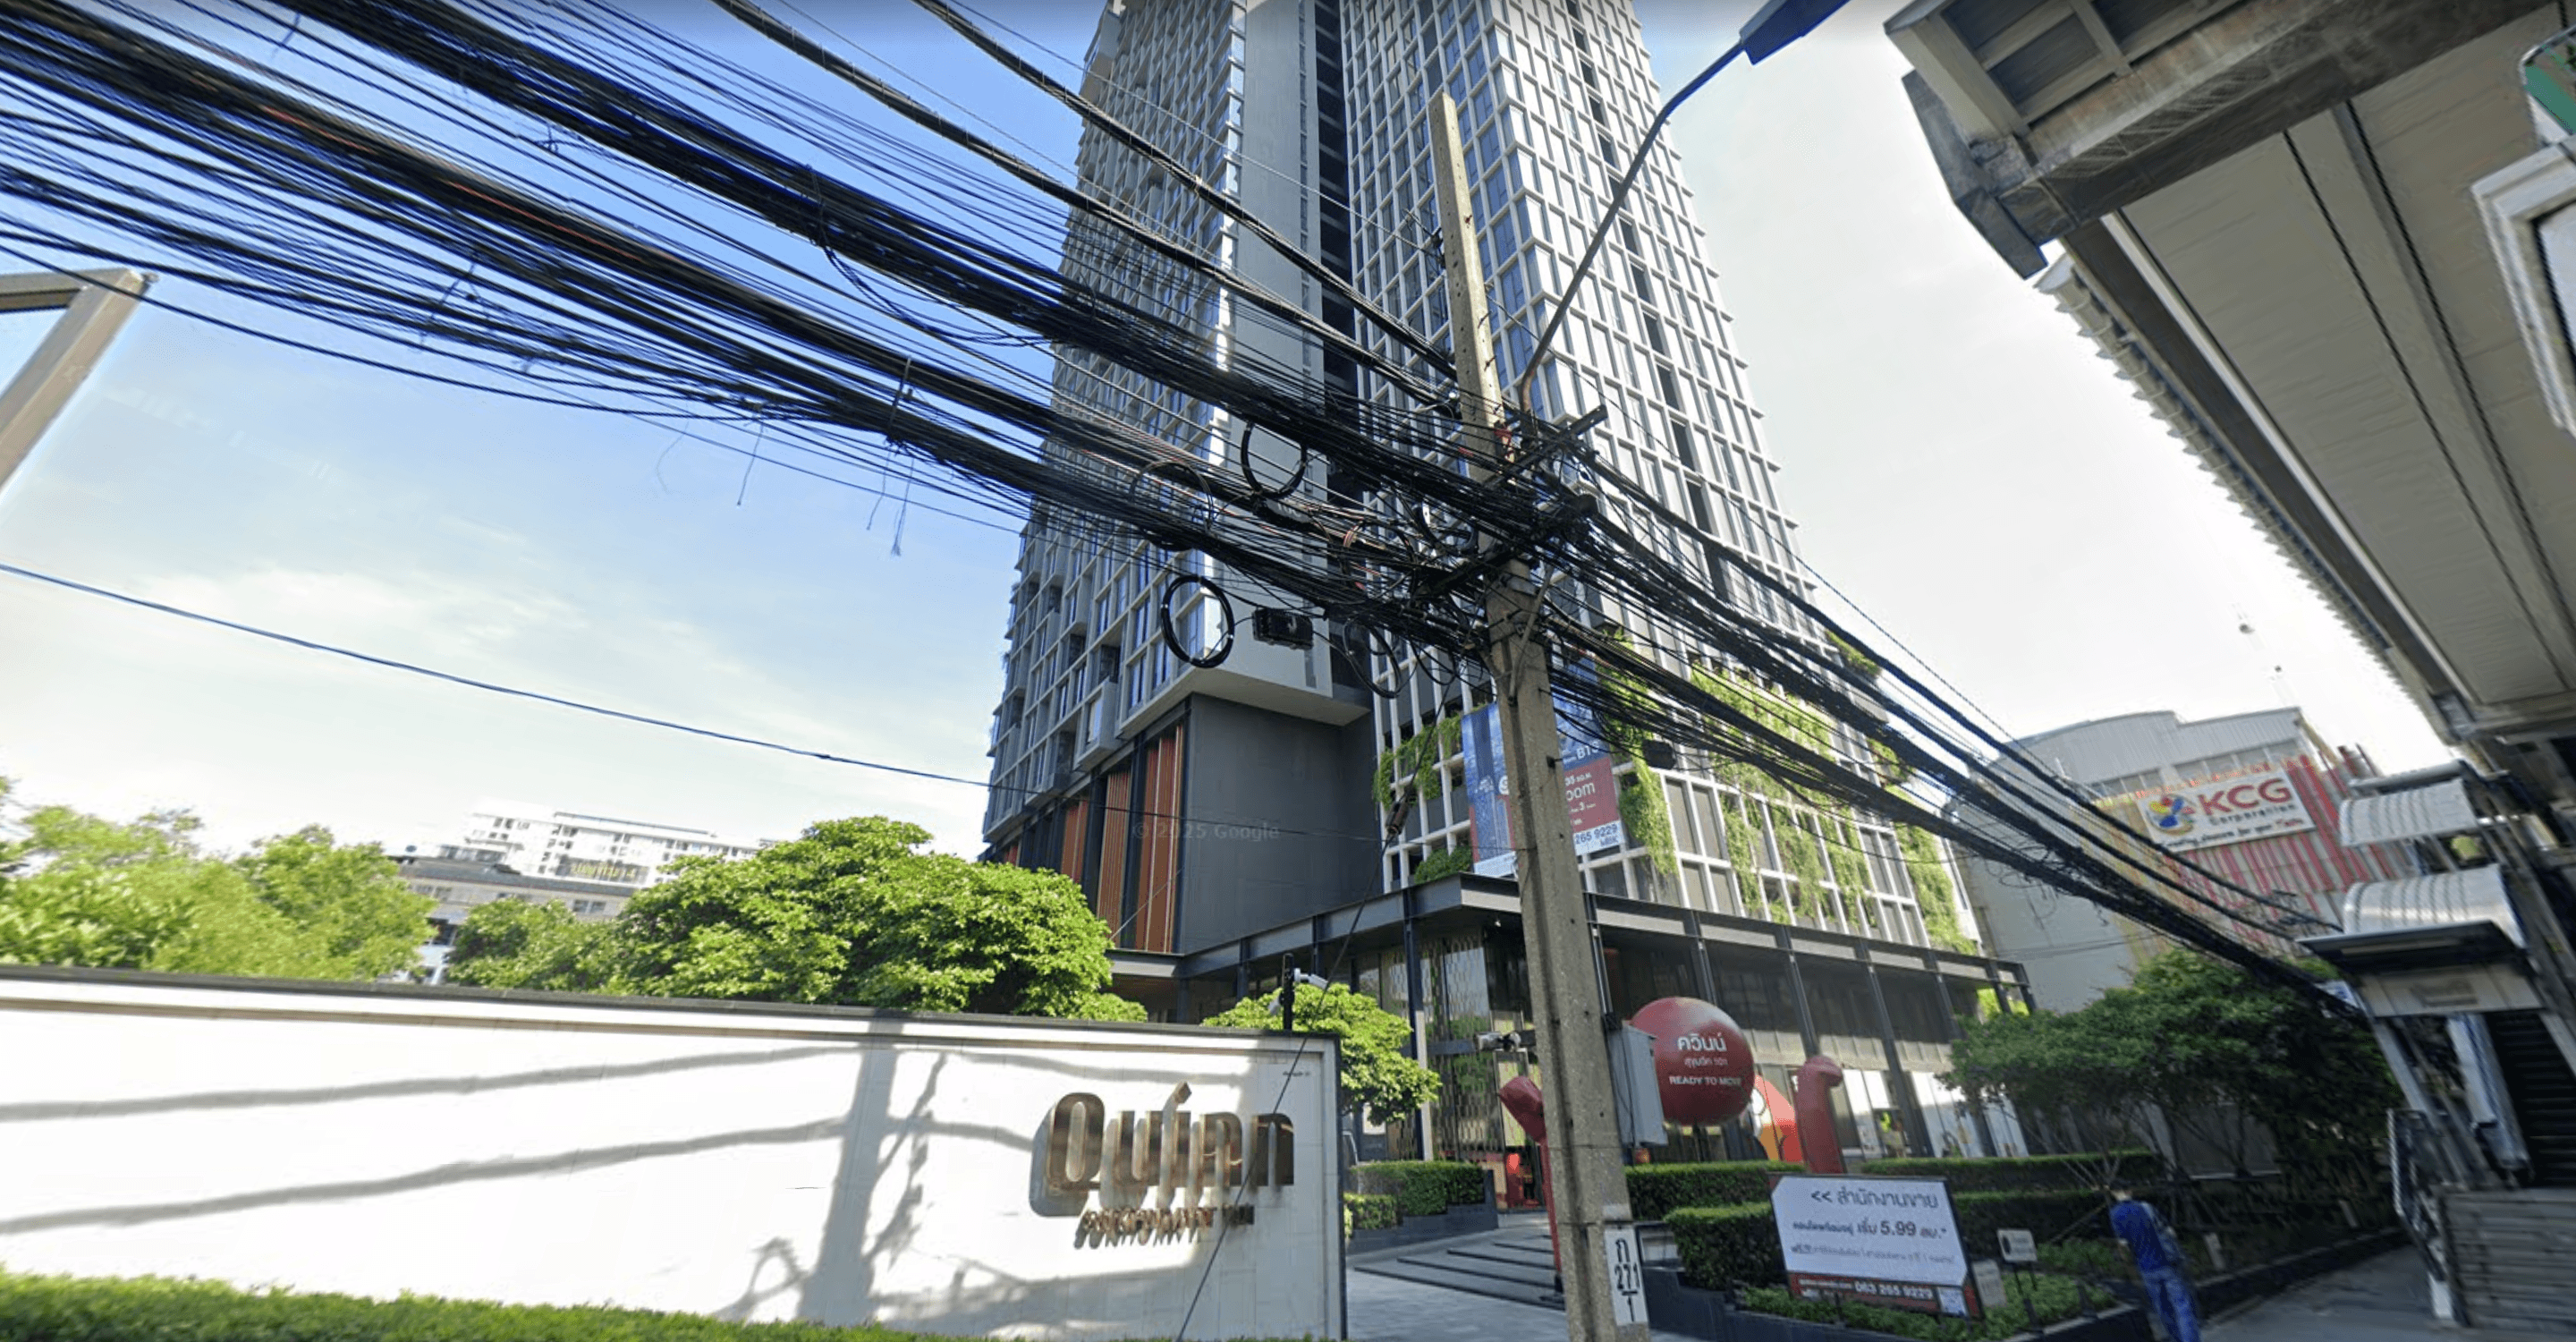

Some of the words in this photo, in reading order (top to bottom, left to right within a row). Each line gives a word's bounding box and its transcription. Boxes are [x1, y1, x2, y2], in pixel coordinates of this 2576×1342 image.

[1576, 741, 1600, 760] BTS
[2197, 777, 2292, 816] KCG
[1677, 1032, 1727, 1052] ควินน์
[1669, 1075, 1703, 1085] READY
[1704, 1076, 1717, 1085] TO
[1836, 1185, 1939, 1209] สำนักงานขาย
[1880, 1219, 1917, 1236] 5.99
[1614, 1238, 1631, 1263] ก
